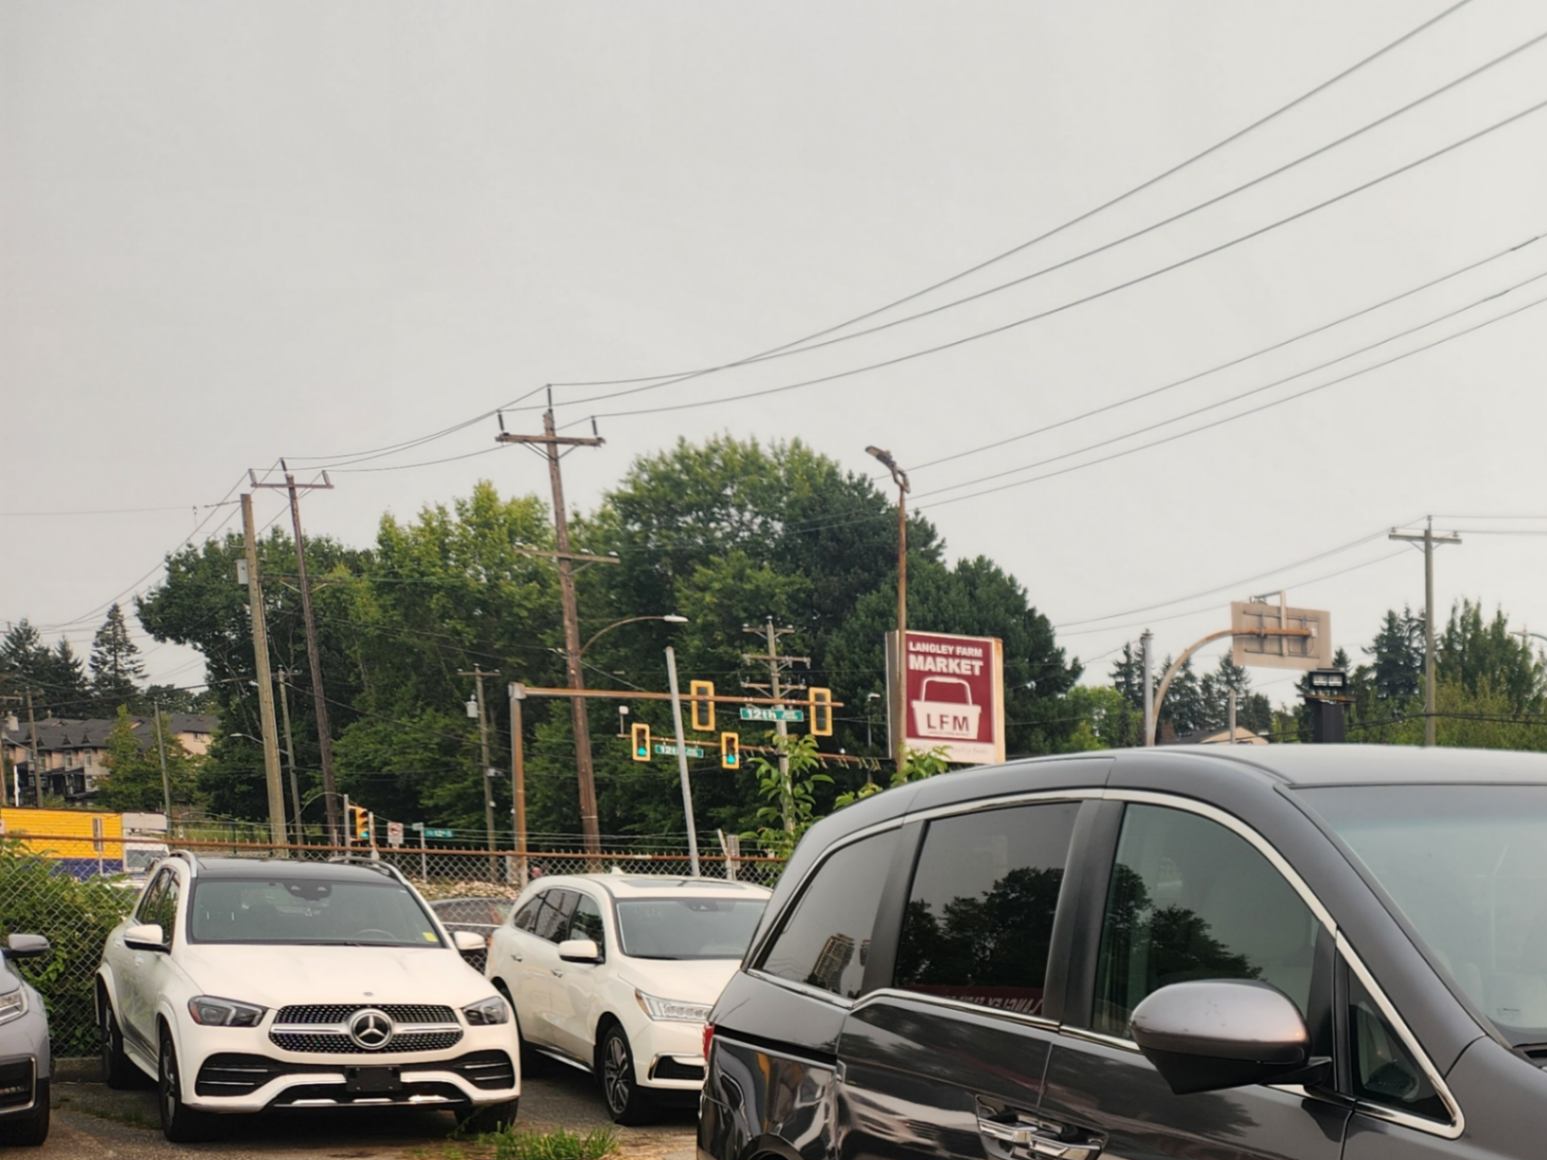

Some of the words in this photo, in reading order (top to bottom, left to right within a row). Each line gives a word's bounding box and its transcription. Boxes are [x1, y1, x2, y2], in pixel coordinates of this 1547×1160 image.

[908, 641, 954, 656] LANGLEY
[956, 646, 983, 658] FARM
[908, 654, 984, 676] MARKET
